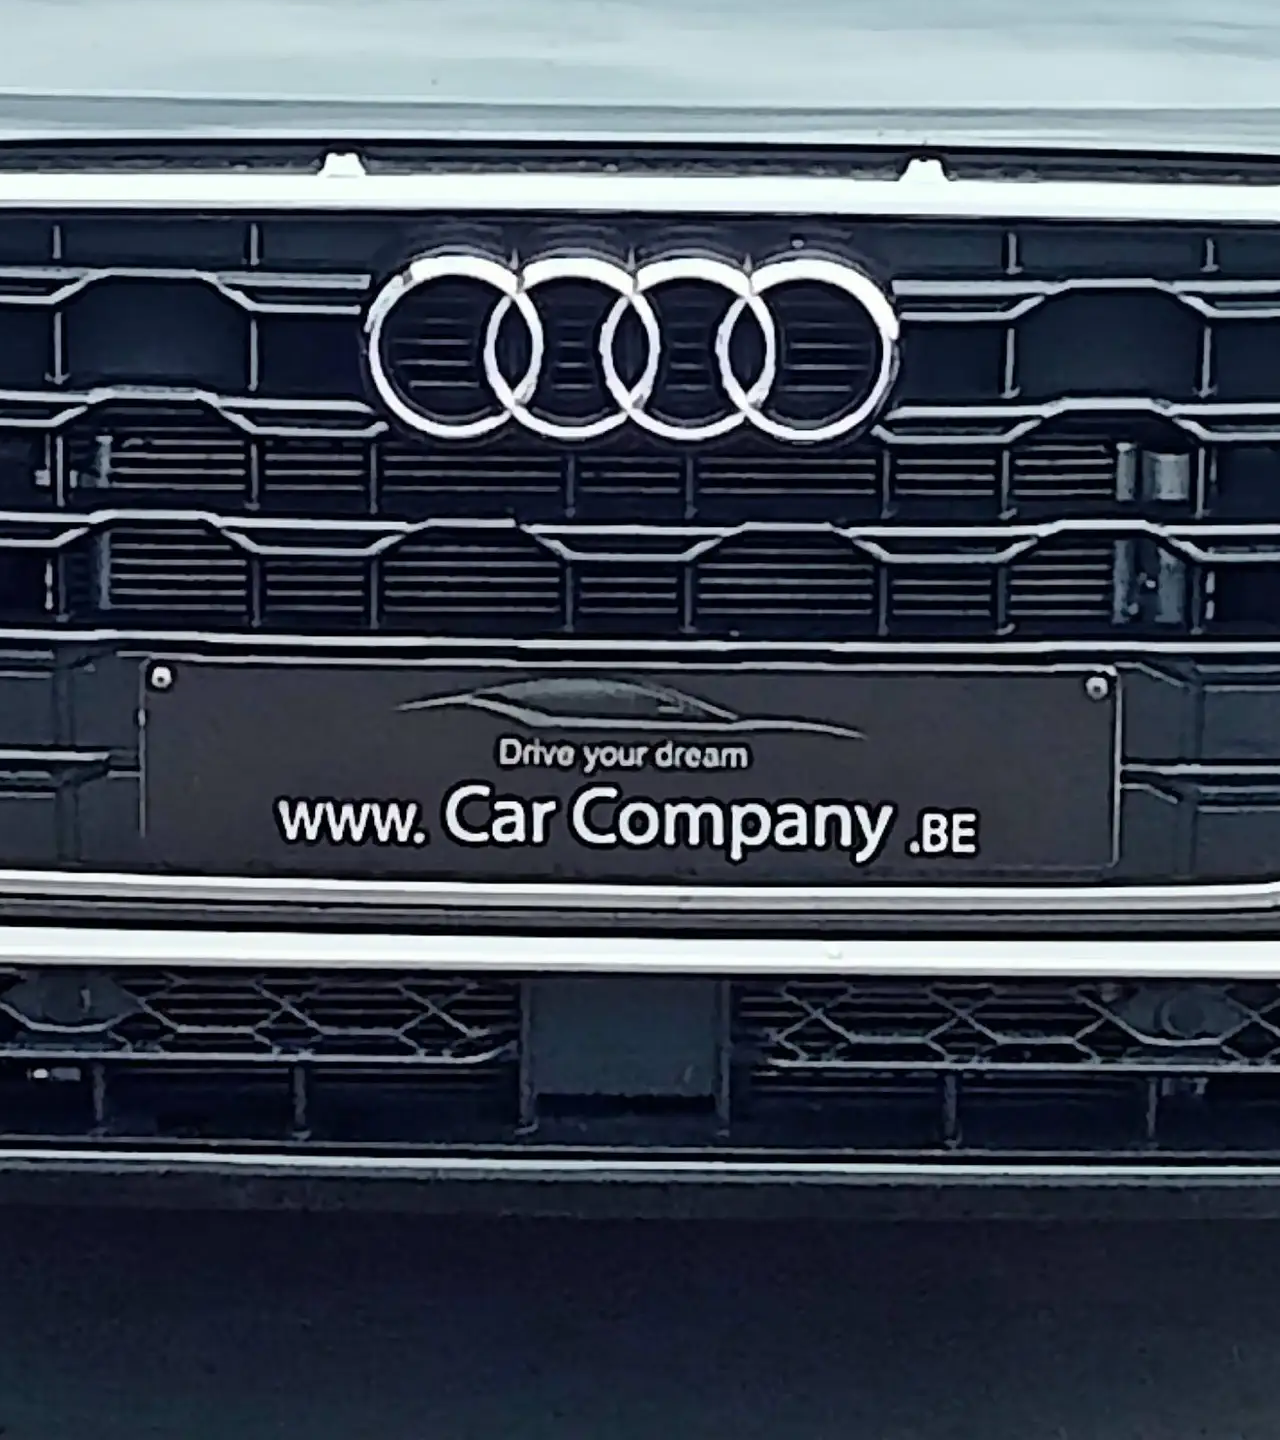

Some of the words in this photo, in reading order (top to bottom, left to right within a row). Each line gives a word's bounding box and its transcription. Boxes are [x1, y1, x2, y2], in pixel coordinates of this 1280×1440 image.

[499, 737, 575, 767] Drive
[582, 744, 649, 773] your
[654, 739, 749, 769] dream
[277, 799, 426, 845] www.
[445, 784, 557, 844] Car
[572, 786, 894, 864] Company
[909, 812, 977, 855] .BE
